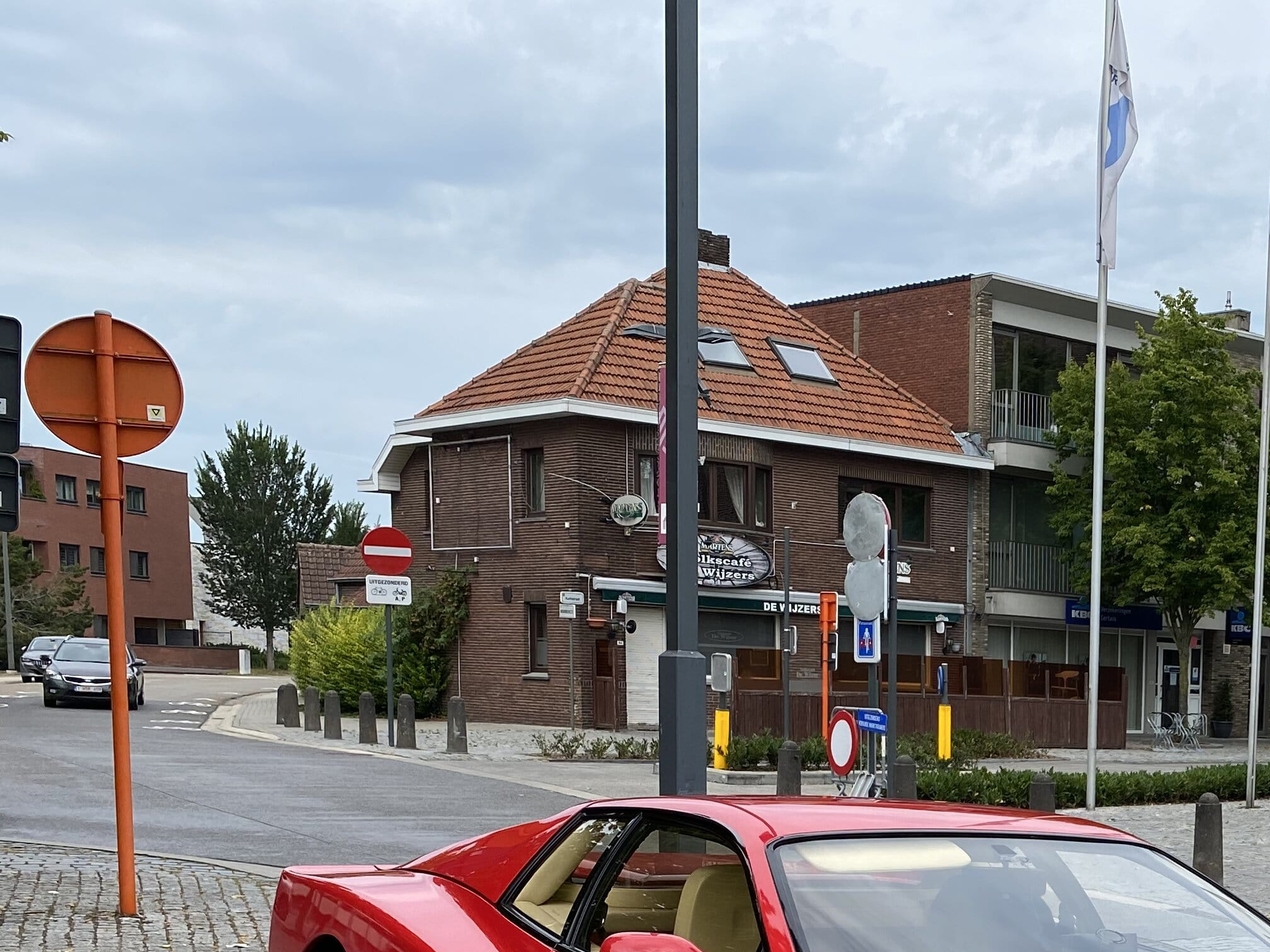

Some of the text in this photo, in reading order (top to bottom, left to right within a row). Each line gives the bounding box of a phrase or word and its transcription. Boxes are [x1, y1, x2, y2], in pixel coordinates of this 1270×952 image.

[702, 567, 756, 581] Wijzers
[763, 602, 778, 612] DE
[1230, 624, 1252, 633] KBC
